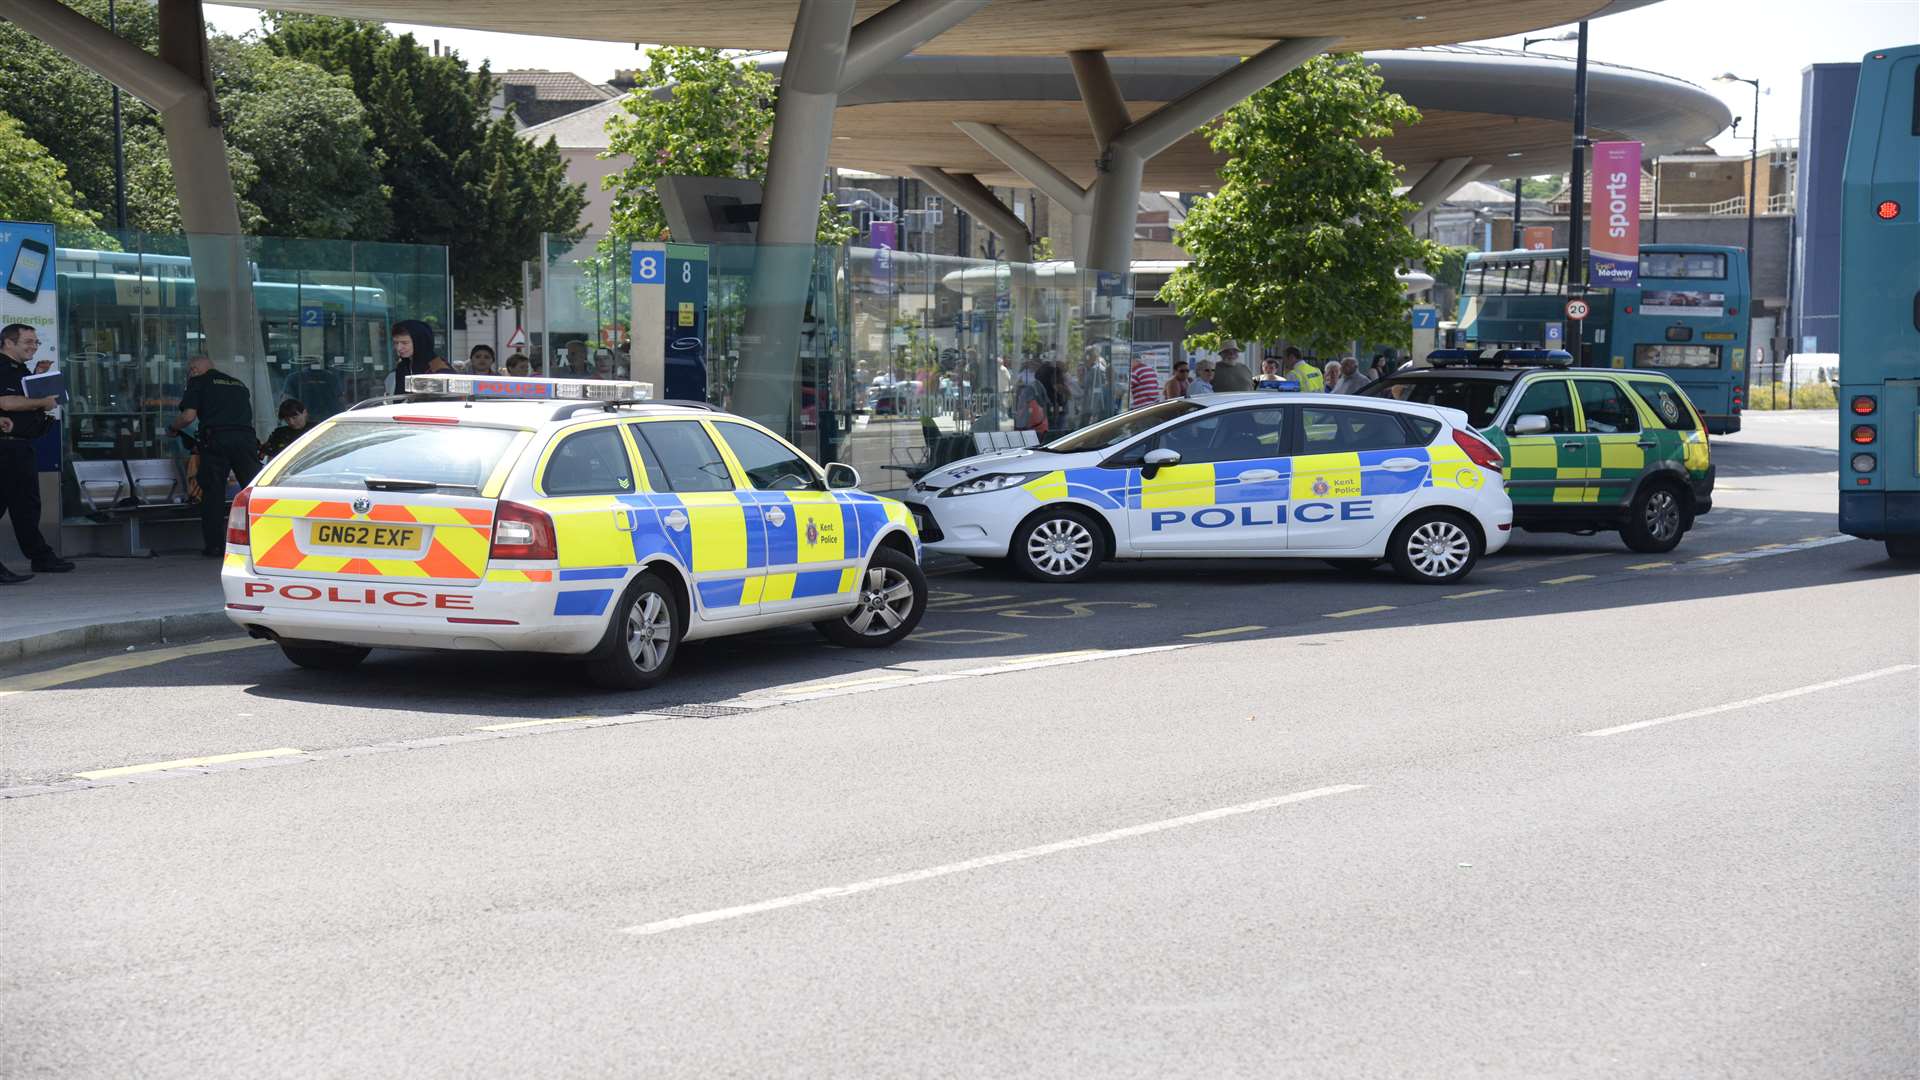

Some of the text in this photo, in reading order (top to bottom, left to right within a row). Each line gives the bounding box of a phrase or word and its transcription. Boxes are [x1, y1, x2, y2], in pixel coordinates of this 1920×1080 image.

[1607, 172, 1630, 238] sports
[639, 256, 657, 279] 8
[682, 261, 691, 283] 8
[1598, 269, 1633, 279] Medway
[306, 310, 318, 324] 2
[1570, 305, 1586, 315] 20
[1418, 312, 1431, 326] 7
[1549, 328, 1558, 338] 6
[478, 383, 546, 394] POLICE
[1334, 478, 1355, 487] Kent
[1335, 486, 1361, 495] Police
[1151, 500, 1375, 532] POLICE
[318, 525, 414, 547] GN62 EXF
[820, 535, 838, 544] Police
[244, 582, 475, 611] POLICE
